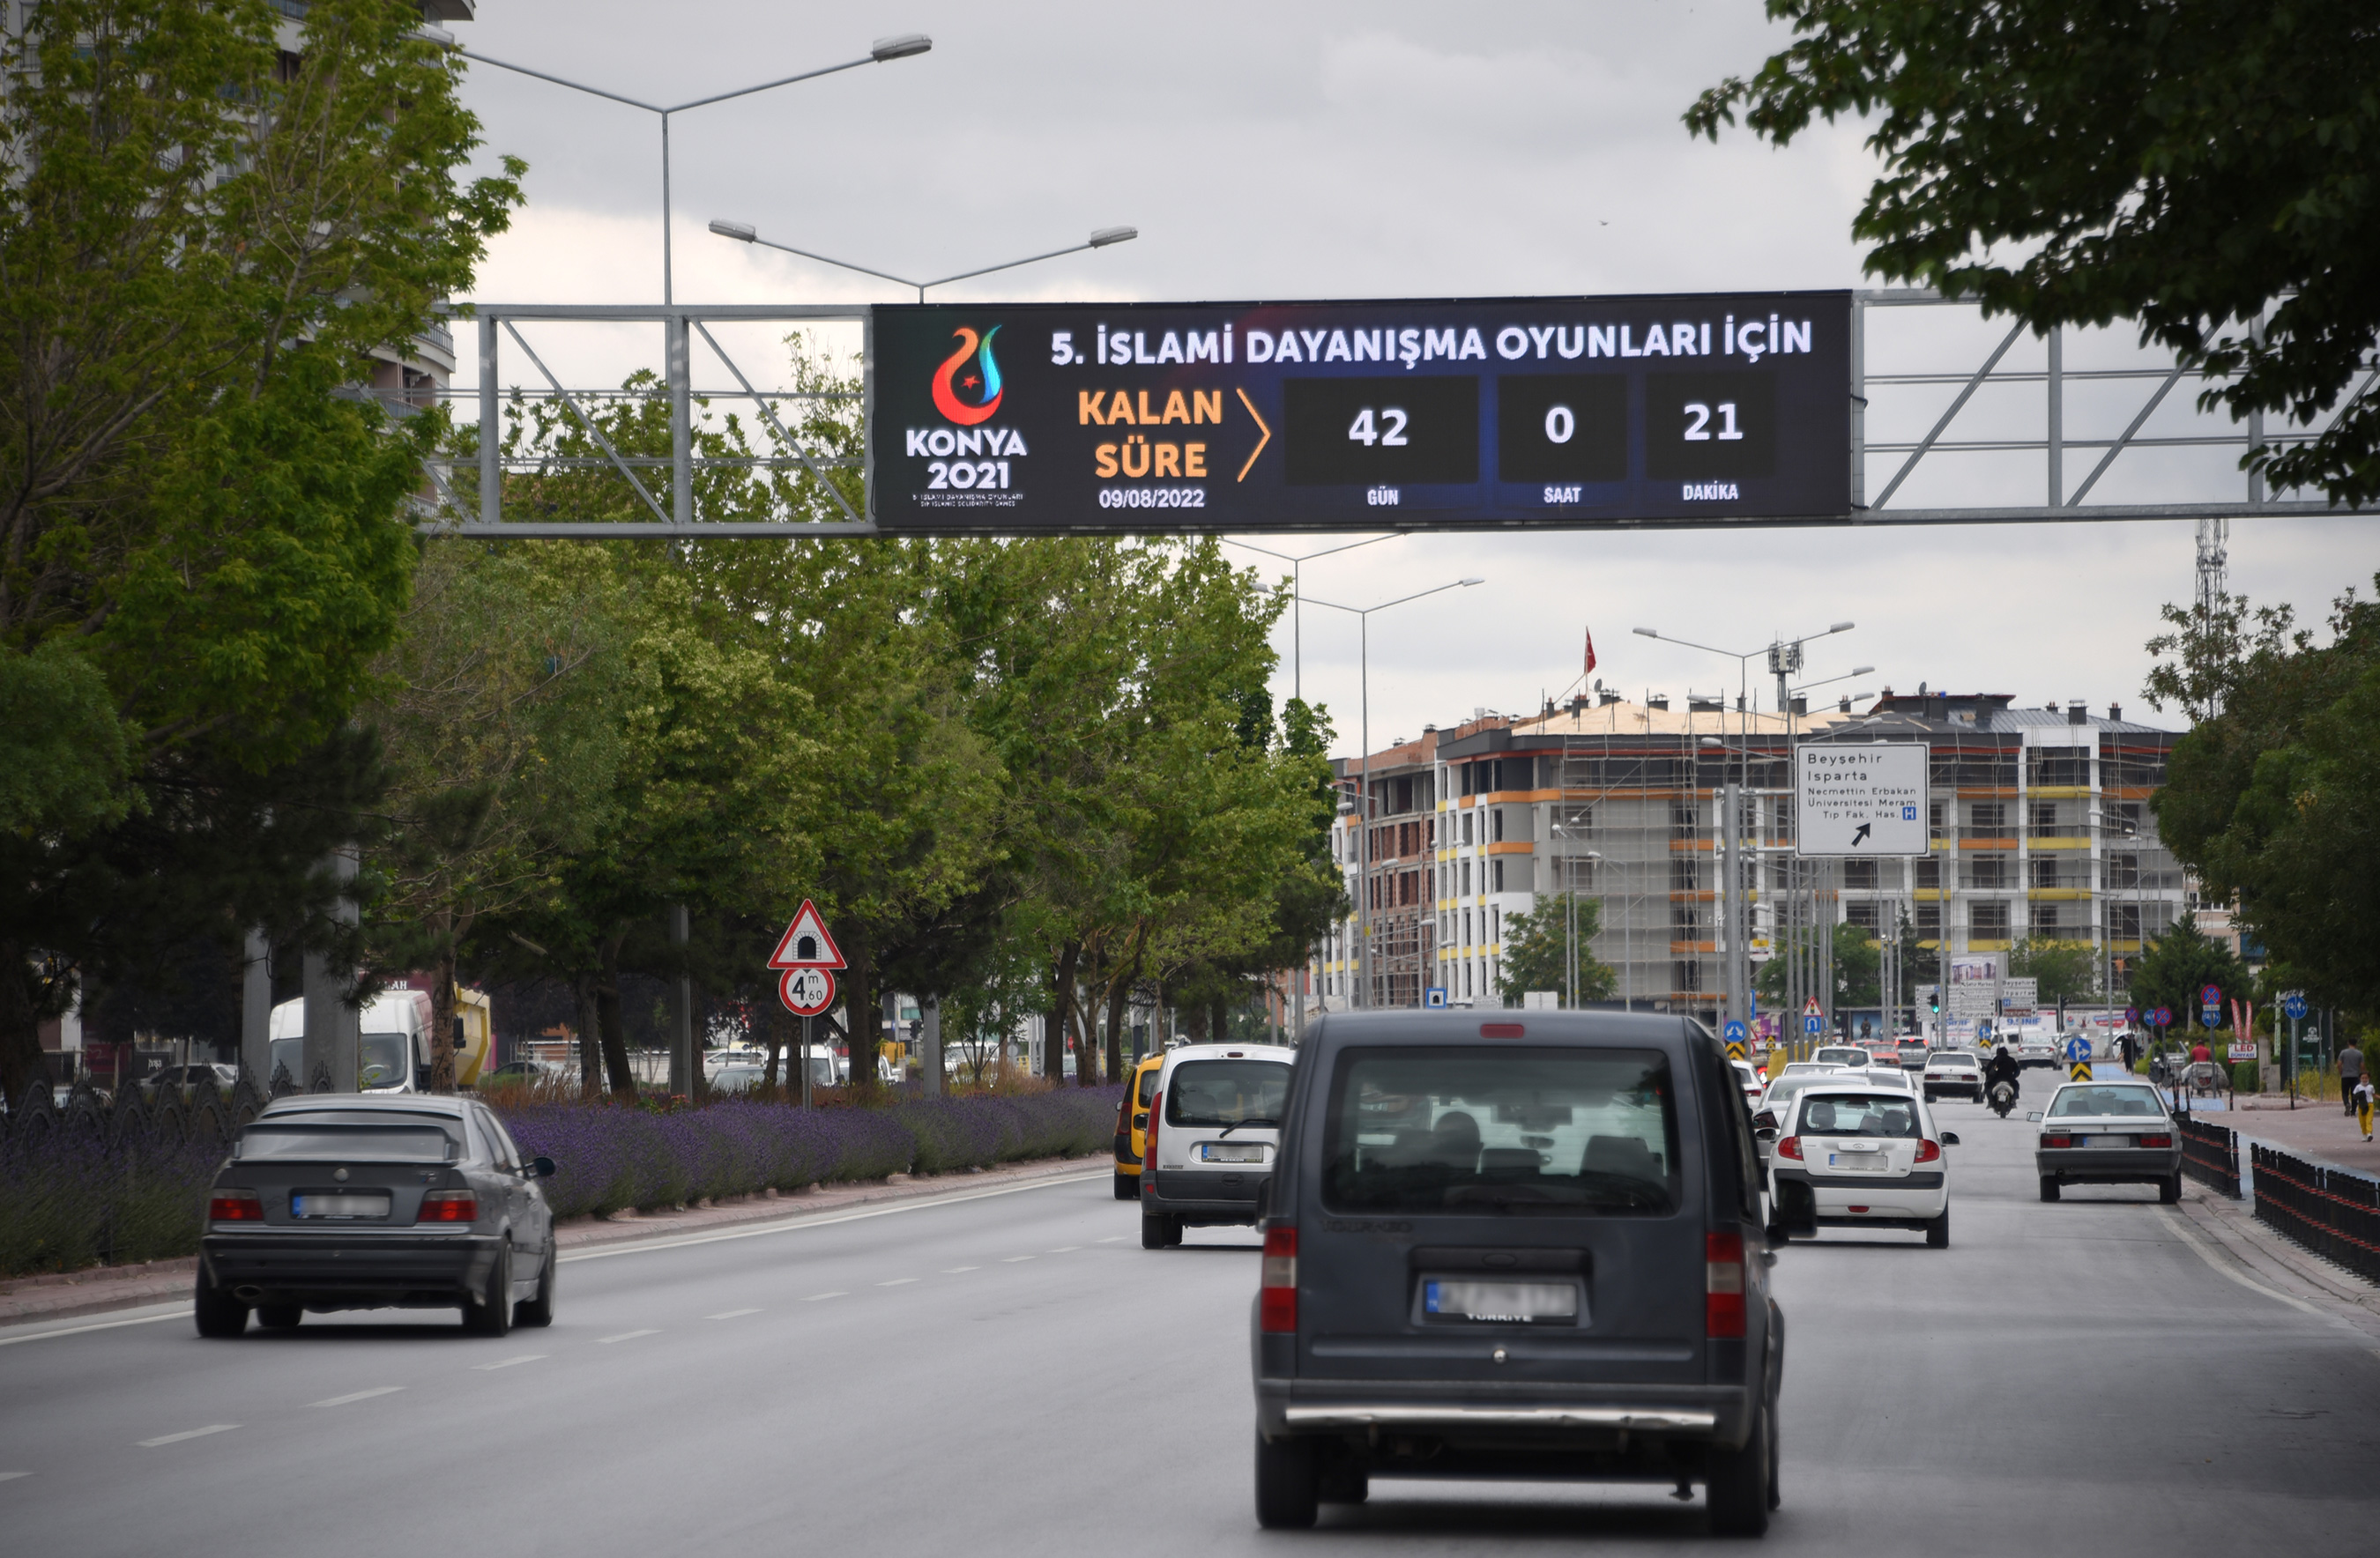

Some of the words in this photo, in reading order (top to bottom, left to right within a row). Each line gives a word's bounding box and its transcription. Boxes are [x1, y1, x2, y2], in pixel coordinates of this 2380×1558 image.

[1050, 331, 1084, 366] 5.
[1097, 323, 1234, 365] İSLAMİ
[1246, 327, 1488, 370] DAYANIŞMA
[1495, 323, 1712, 362] OYUNLARI
[1723, 313, 1813, 364] İÇİN
[1078, 390, 1223, 426] KALAN
[1348, 408, 1409, 447] 42
[1544, 405, 1575, 444] 0
[1683, 403, 1744, 441] 21
[905, 428, 1029, 457] KONYA
[1094, 434, 1209, 479] SÜRE
[926, 460, 1010, 490] 2021
[1097, 488, 1206, 508] 09/08/2022
[1365, 485, 1400, 506] GÜN
[1543, 486, 1582, 504] SAAT
[1682, 480, 1740, 501] DAKİKA
[1807, 753, 1883, 766] Beyşehir
[1807, 770, 1868, 784] Isparta
[1807, 787, 1866, 796] Necmettin
[1807, 797, 1873, 807] Üniversitesi
[1823, 811, 1840, 820] Tıp
[1875, 810, 1900, 819] Has.
